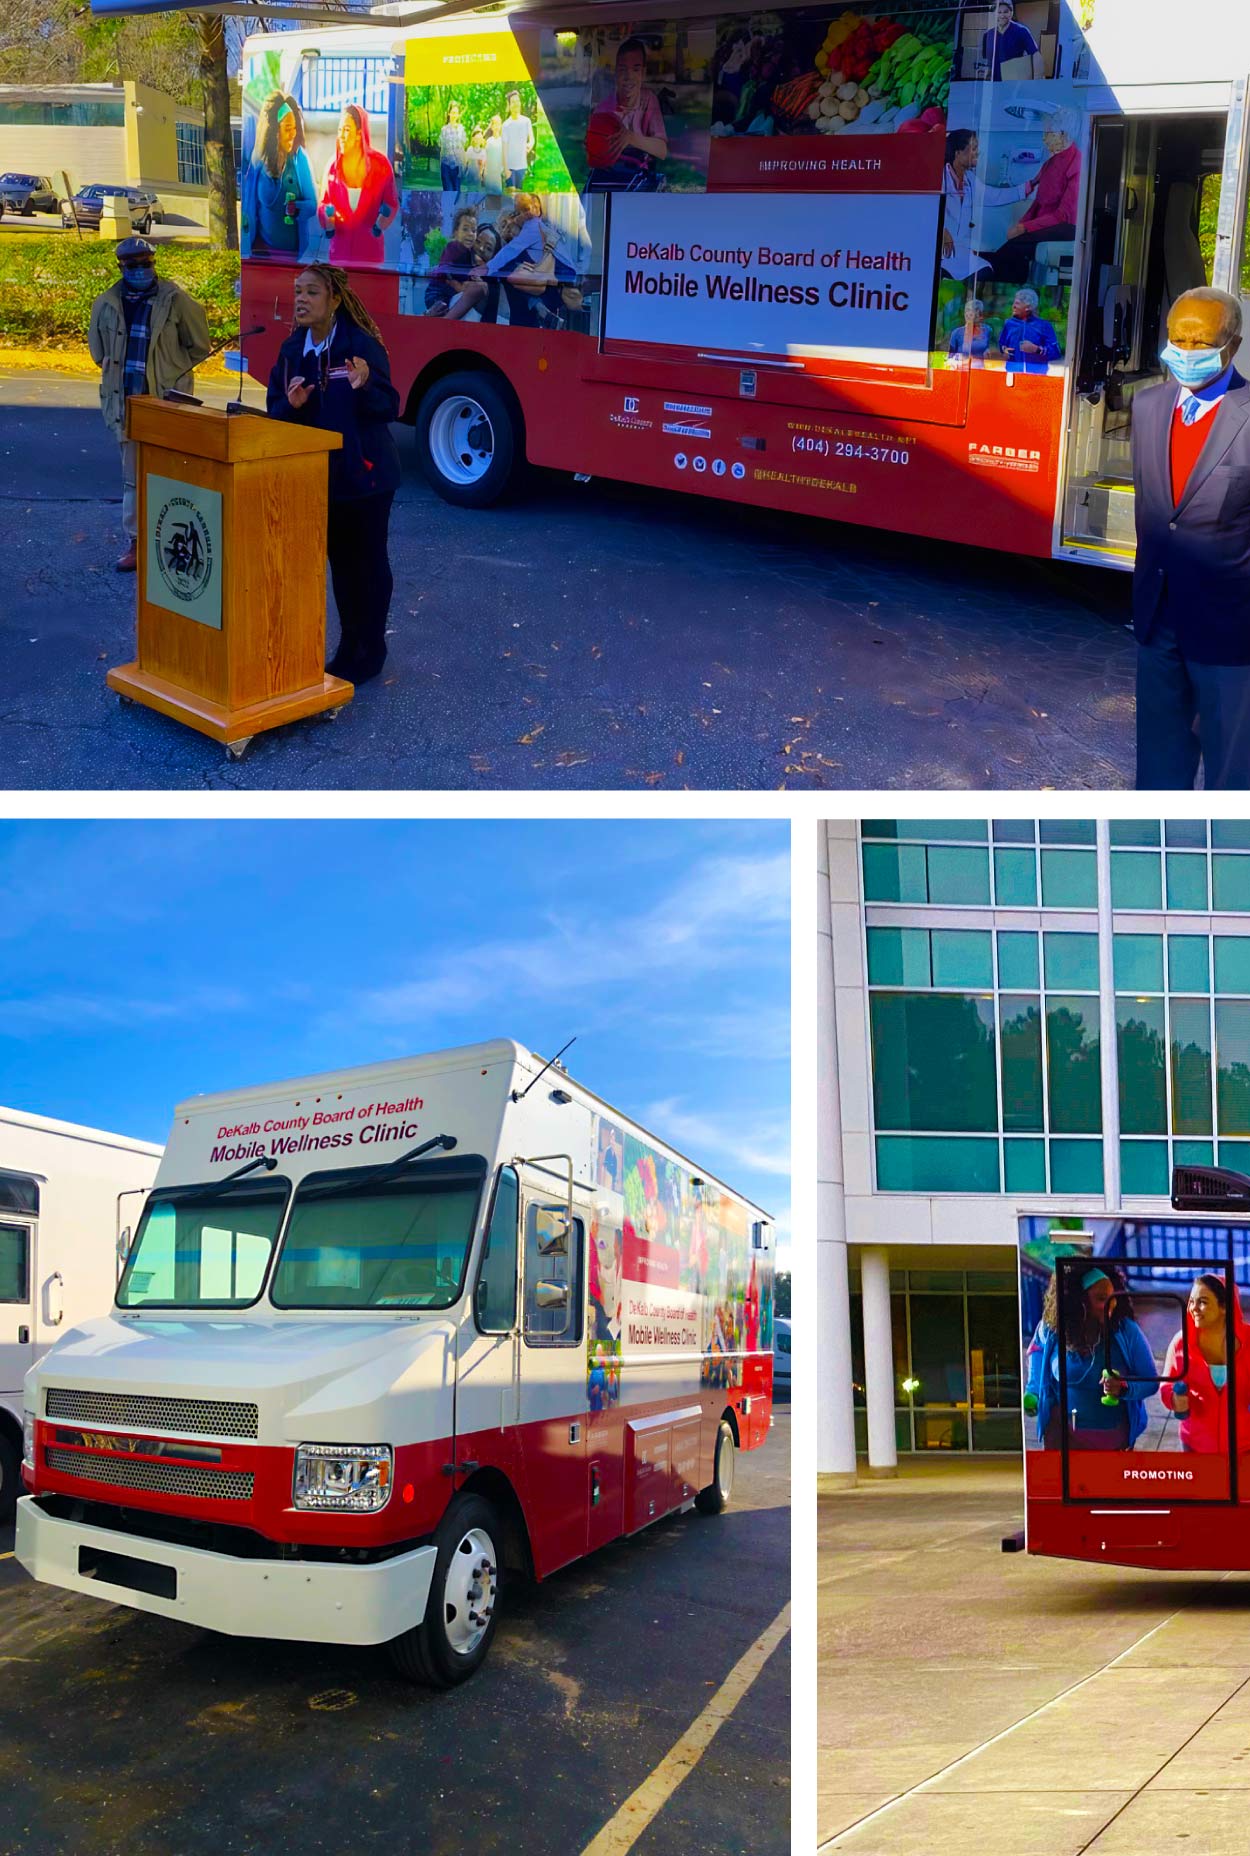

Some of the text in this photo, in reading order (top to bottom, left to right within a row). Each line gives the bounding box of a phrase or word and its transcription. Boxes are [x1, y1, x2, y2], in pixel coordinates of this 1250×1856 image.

[759, 159, 881, 171] IMPROVING HEALTH
[626, 242, 911, 271] DeKalb County Board of Health
[624, 270, 909, 311] Mobile Wellness Clinic
[792, 436, 909, 465] (404) 294-3700
[217, 1097, 424, 1139] DeKalb County Board of Health
[209, 1120, 419, 1163] Mobile Wellness Clinic
[629, 1324, 697, 1345] Mobile Wellness Clinic
[1123, 1470, 1193, 1480] PROMOTING
